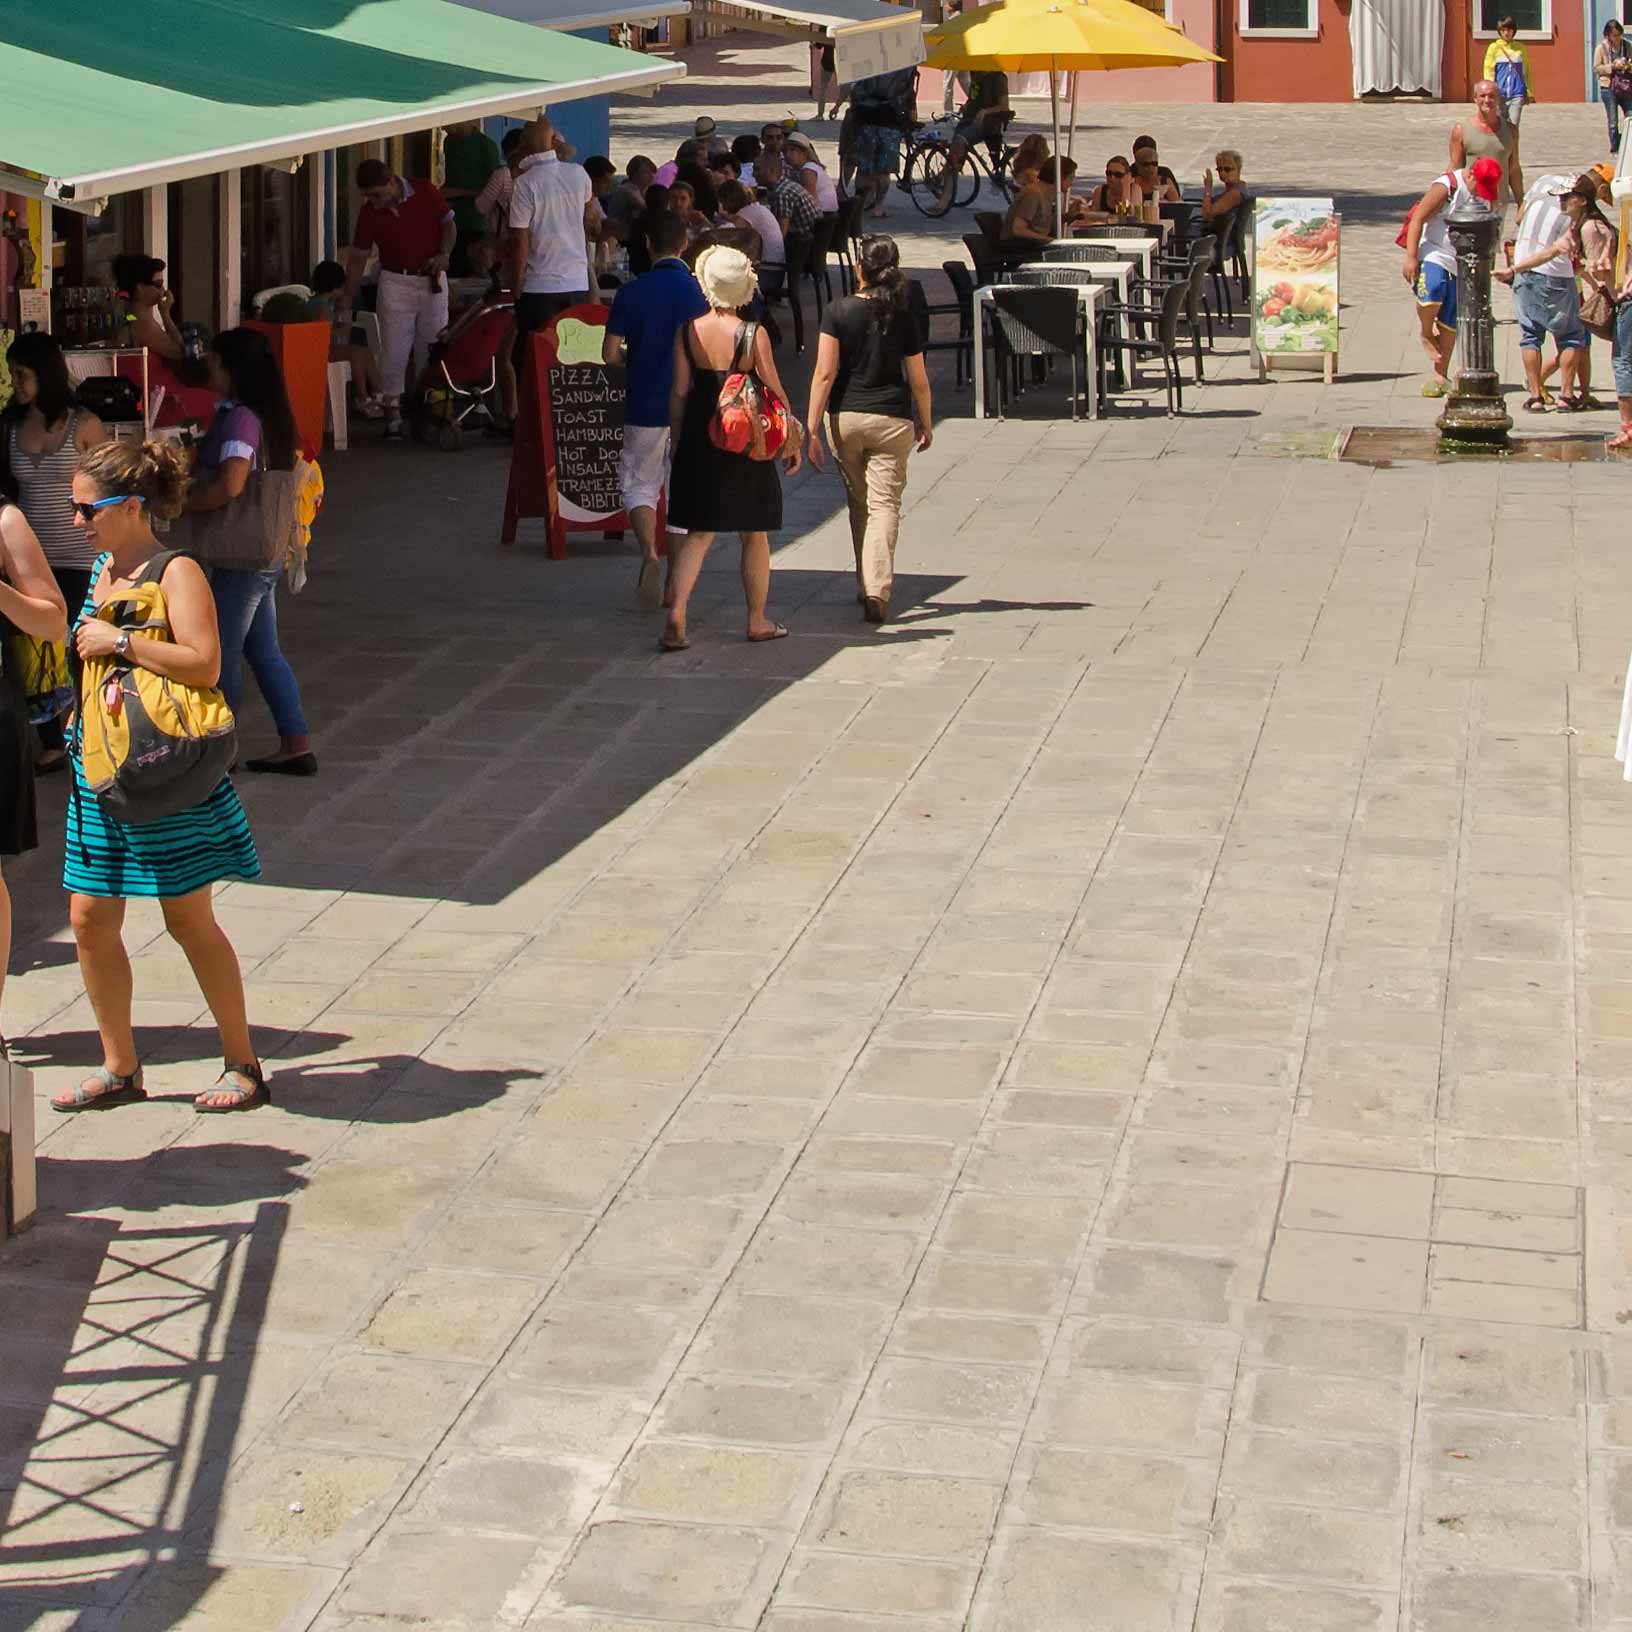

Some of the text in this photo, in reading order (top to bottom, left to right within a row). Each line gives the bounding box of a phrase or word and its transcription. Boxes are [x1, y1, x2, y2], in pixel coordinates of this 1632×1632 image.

[550, 366, 609, 385] PIZZA
[552, 387, 626, 405] SANDWICH
[552, 409, 607, 424] TOAST
